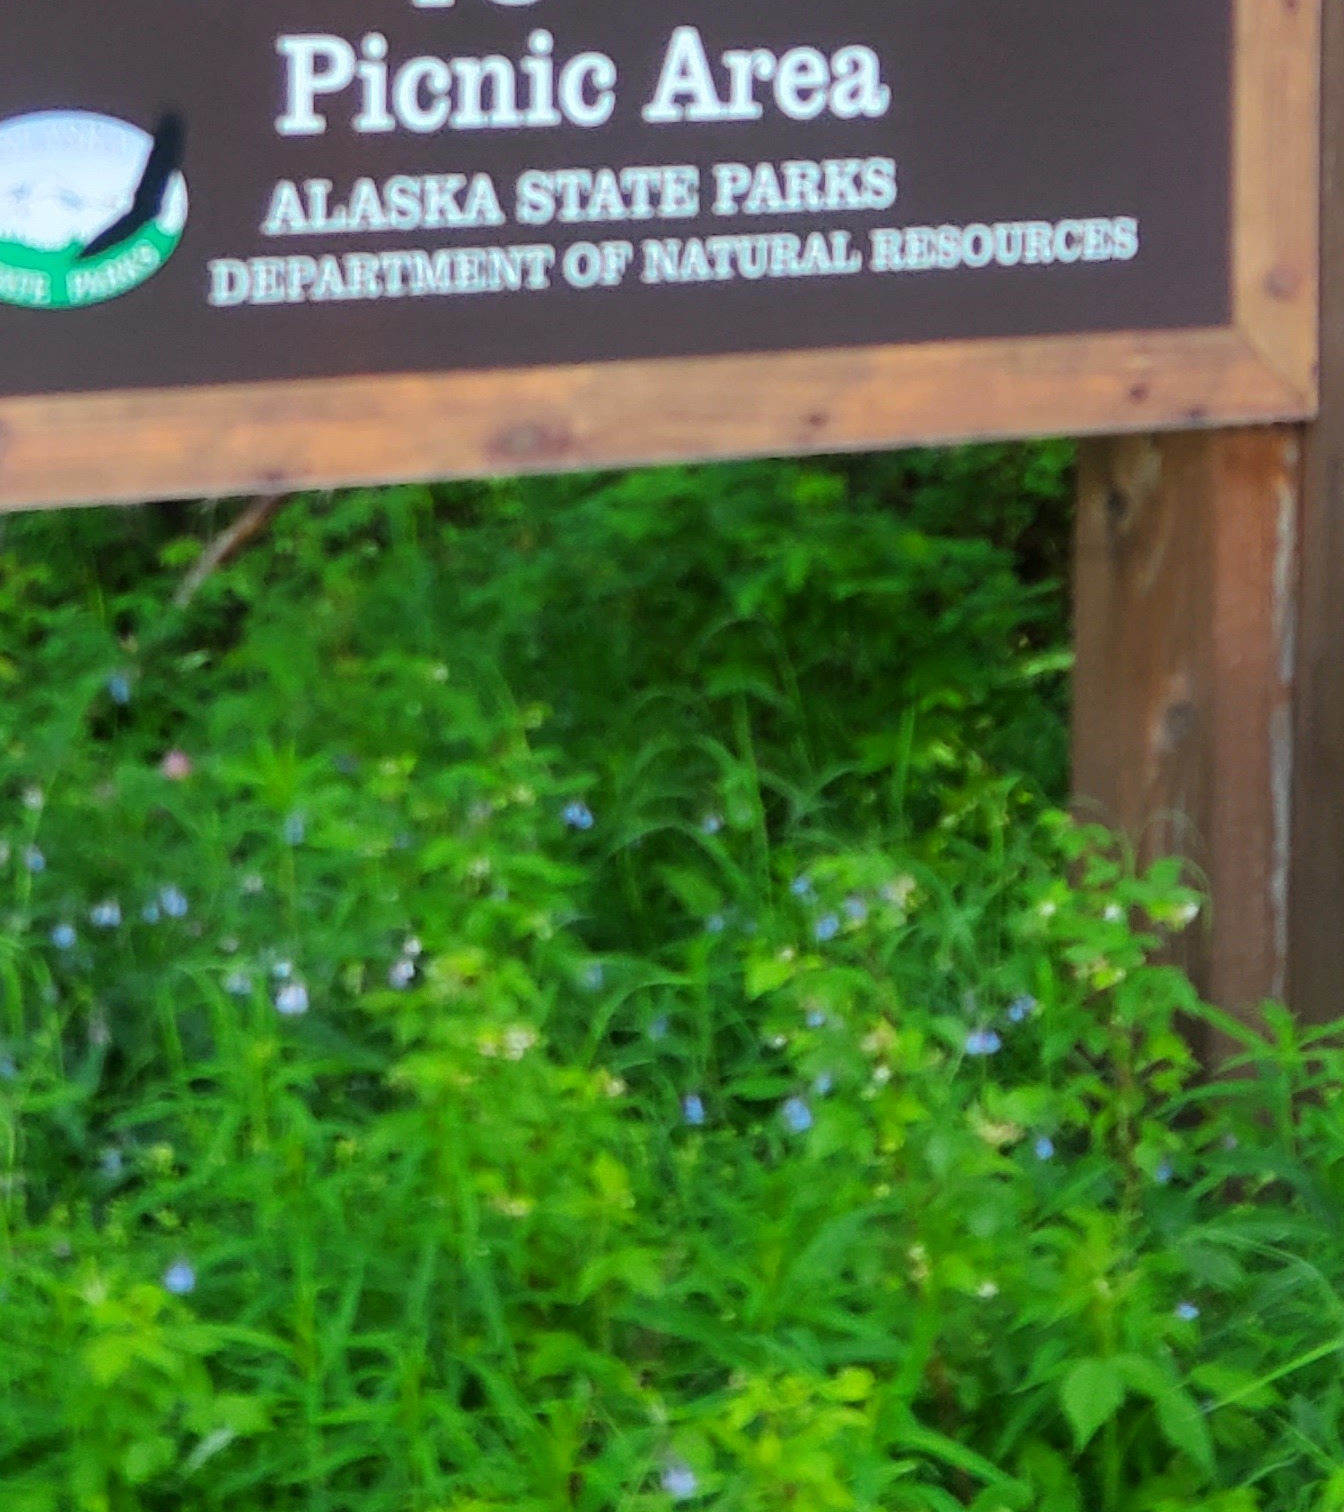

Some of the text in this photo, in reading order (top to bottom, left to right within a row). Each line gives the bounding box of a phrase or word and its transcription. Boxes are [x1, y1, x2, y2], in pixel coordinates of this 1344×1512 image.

[275, 25, 891, 137] Picnic Area
[261, 156, 898, 236] ALASKA STATE PARKS
[207, 215, 1139, 307] DEPARTMENT OF NATURAL RESOURCES
